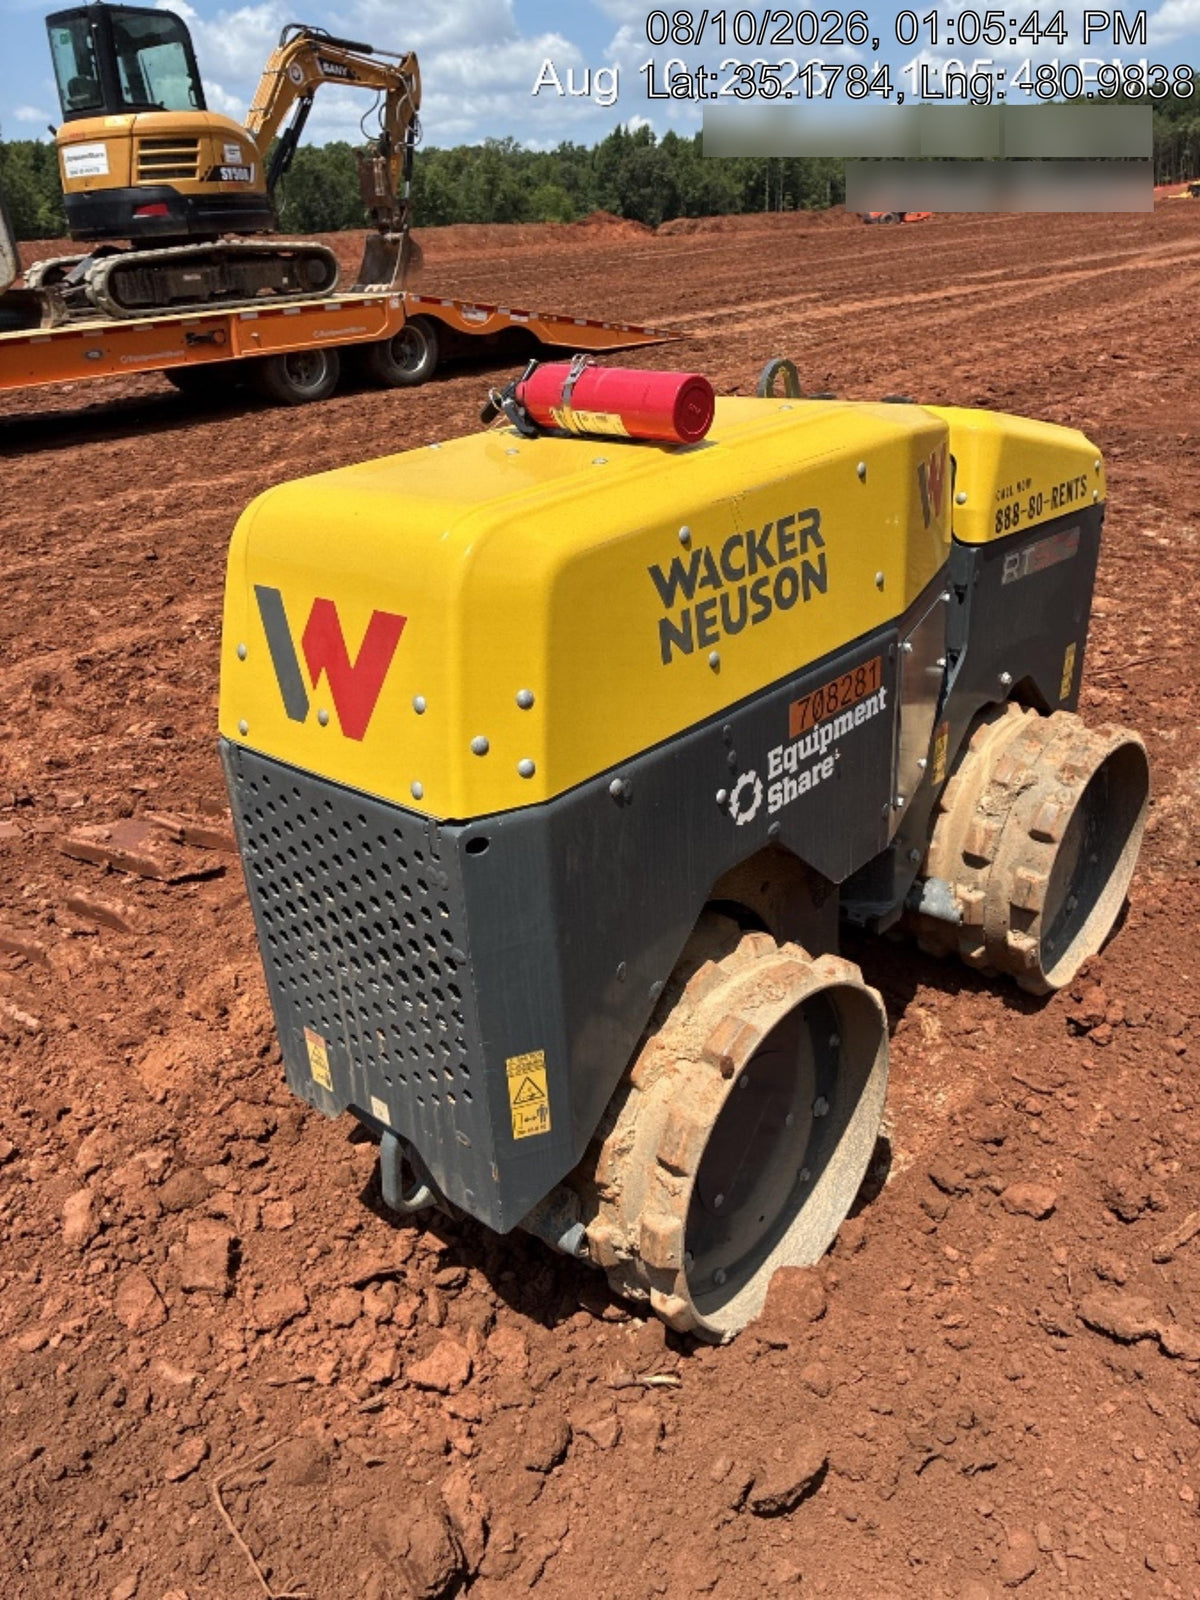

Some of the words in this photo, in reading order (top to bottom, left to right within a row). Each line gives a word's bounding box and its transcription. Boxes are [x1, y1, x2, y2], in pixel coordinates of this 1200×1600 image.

[322, 63, 348, 76] SANY
[995, 474, 1088, 534] 888-80-RENTS
[648, 508, 826, 609] WACKER
[658, 552, 828, 666] NEUSON
[798, 662, 877, 730] 708281
[767, 685, 888, 781] Equipment
[767, 754, 835, 814] Share
